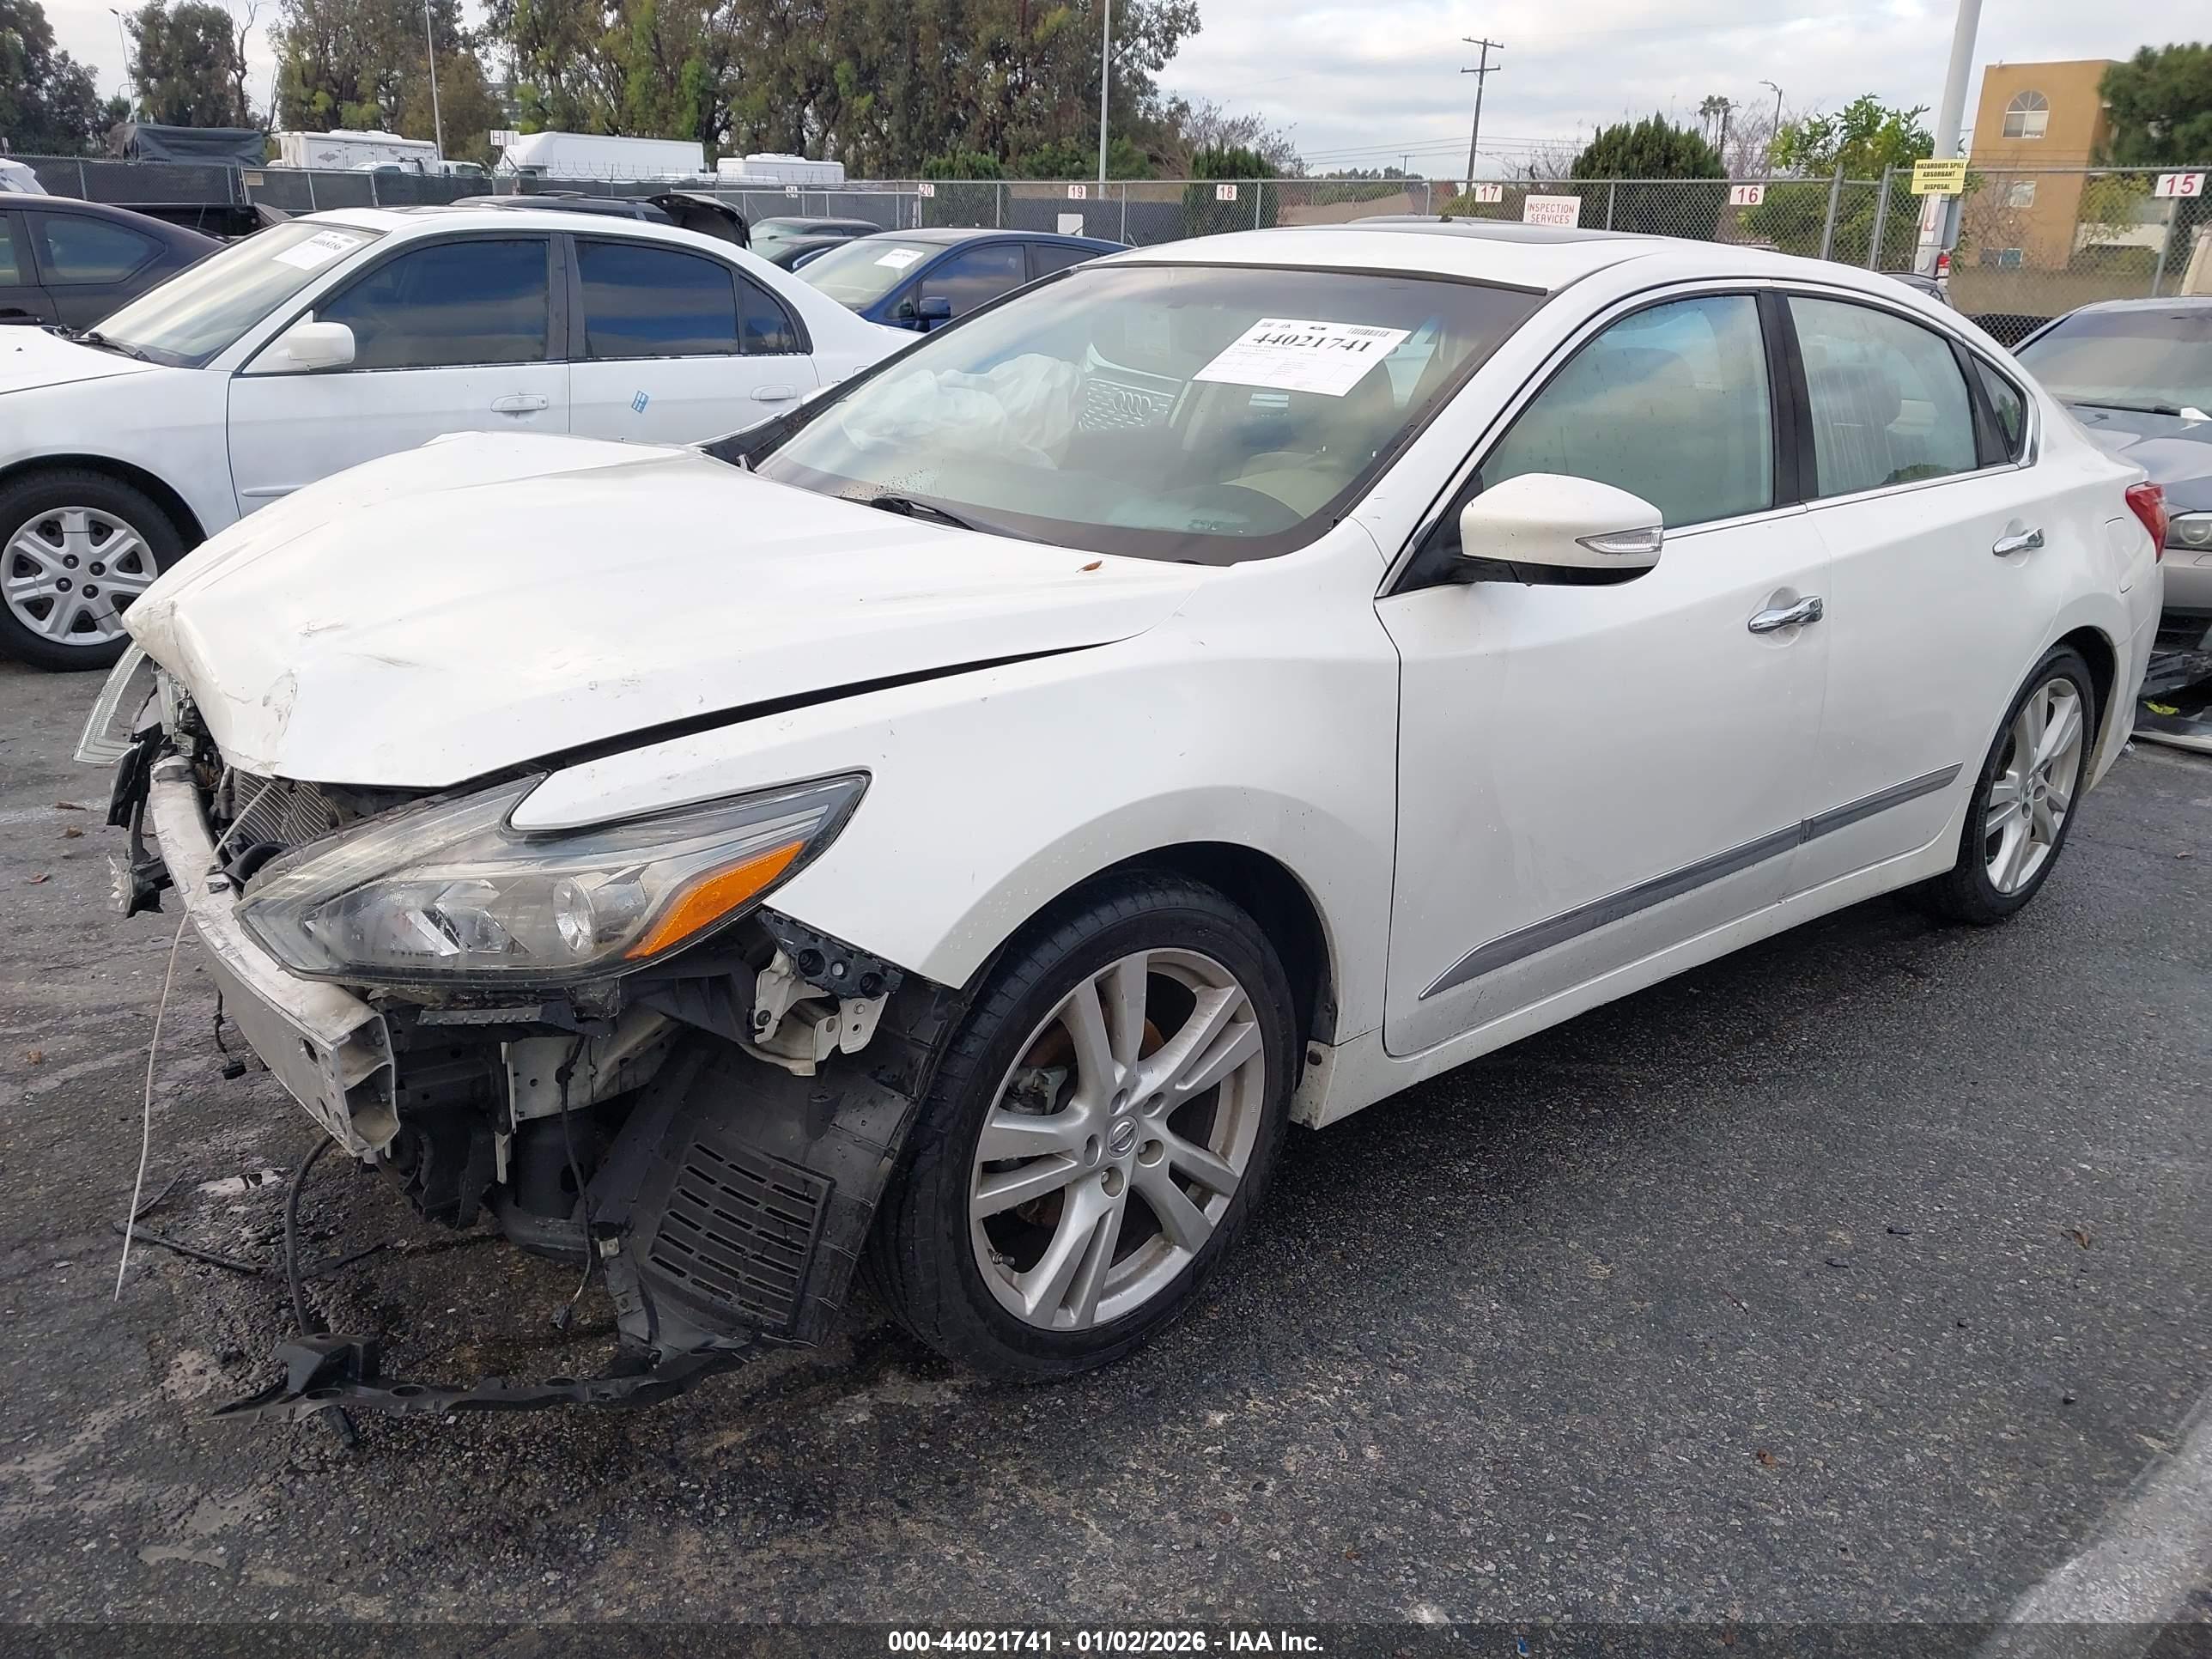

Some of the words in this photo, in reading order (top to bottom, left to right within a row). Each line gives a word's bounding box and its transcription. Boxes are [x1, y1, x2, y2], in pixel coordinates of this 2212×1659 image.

[921, 185, 932, 196] 20
[1072, 185, 1083, 198] 19
[2166, 174, 2197, 195] 15
[1220, 185, 1233, 199] 18
[1481, 185, 1498, 201] 17
[1737, 187, 1759, 204] 16
[1528, 203, 1575, 214] INSPECTION
[1530, 213, 1571, 224] SERVICES
[1252, 332, 1375, 353] 44021741
